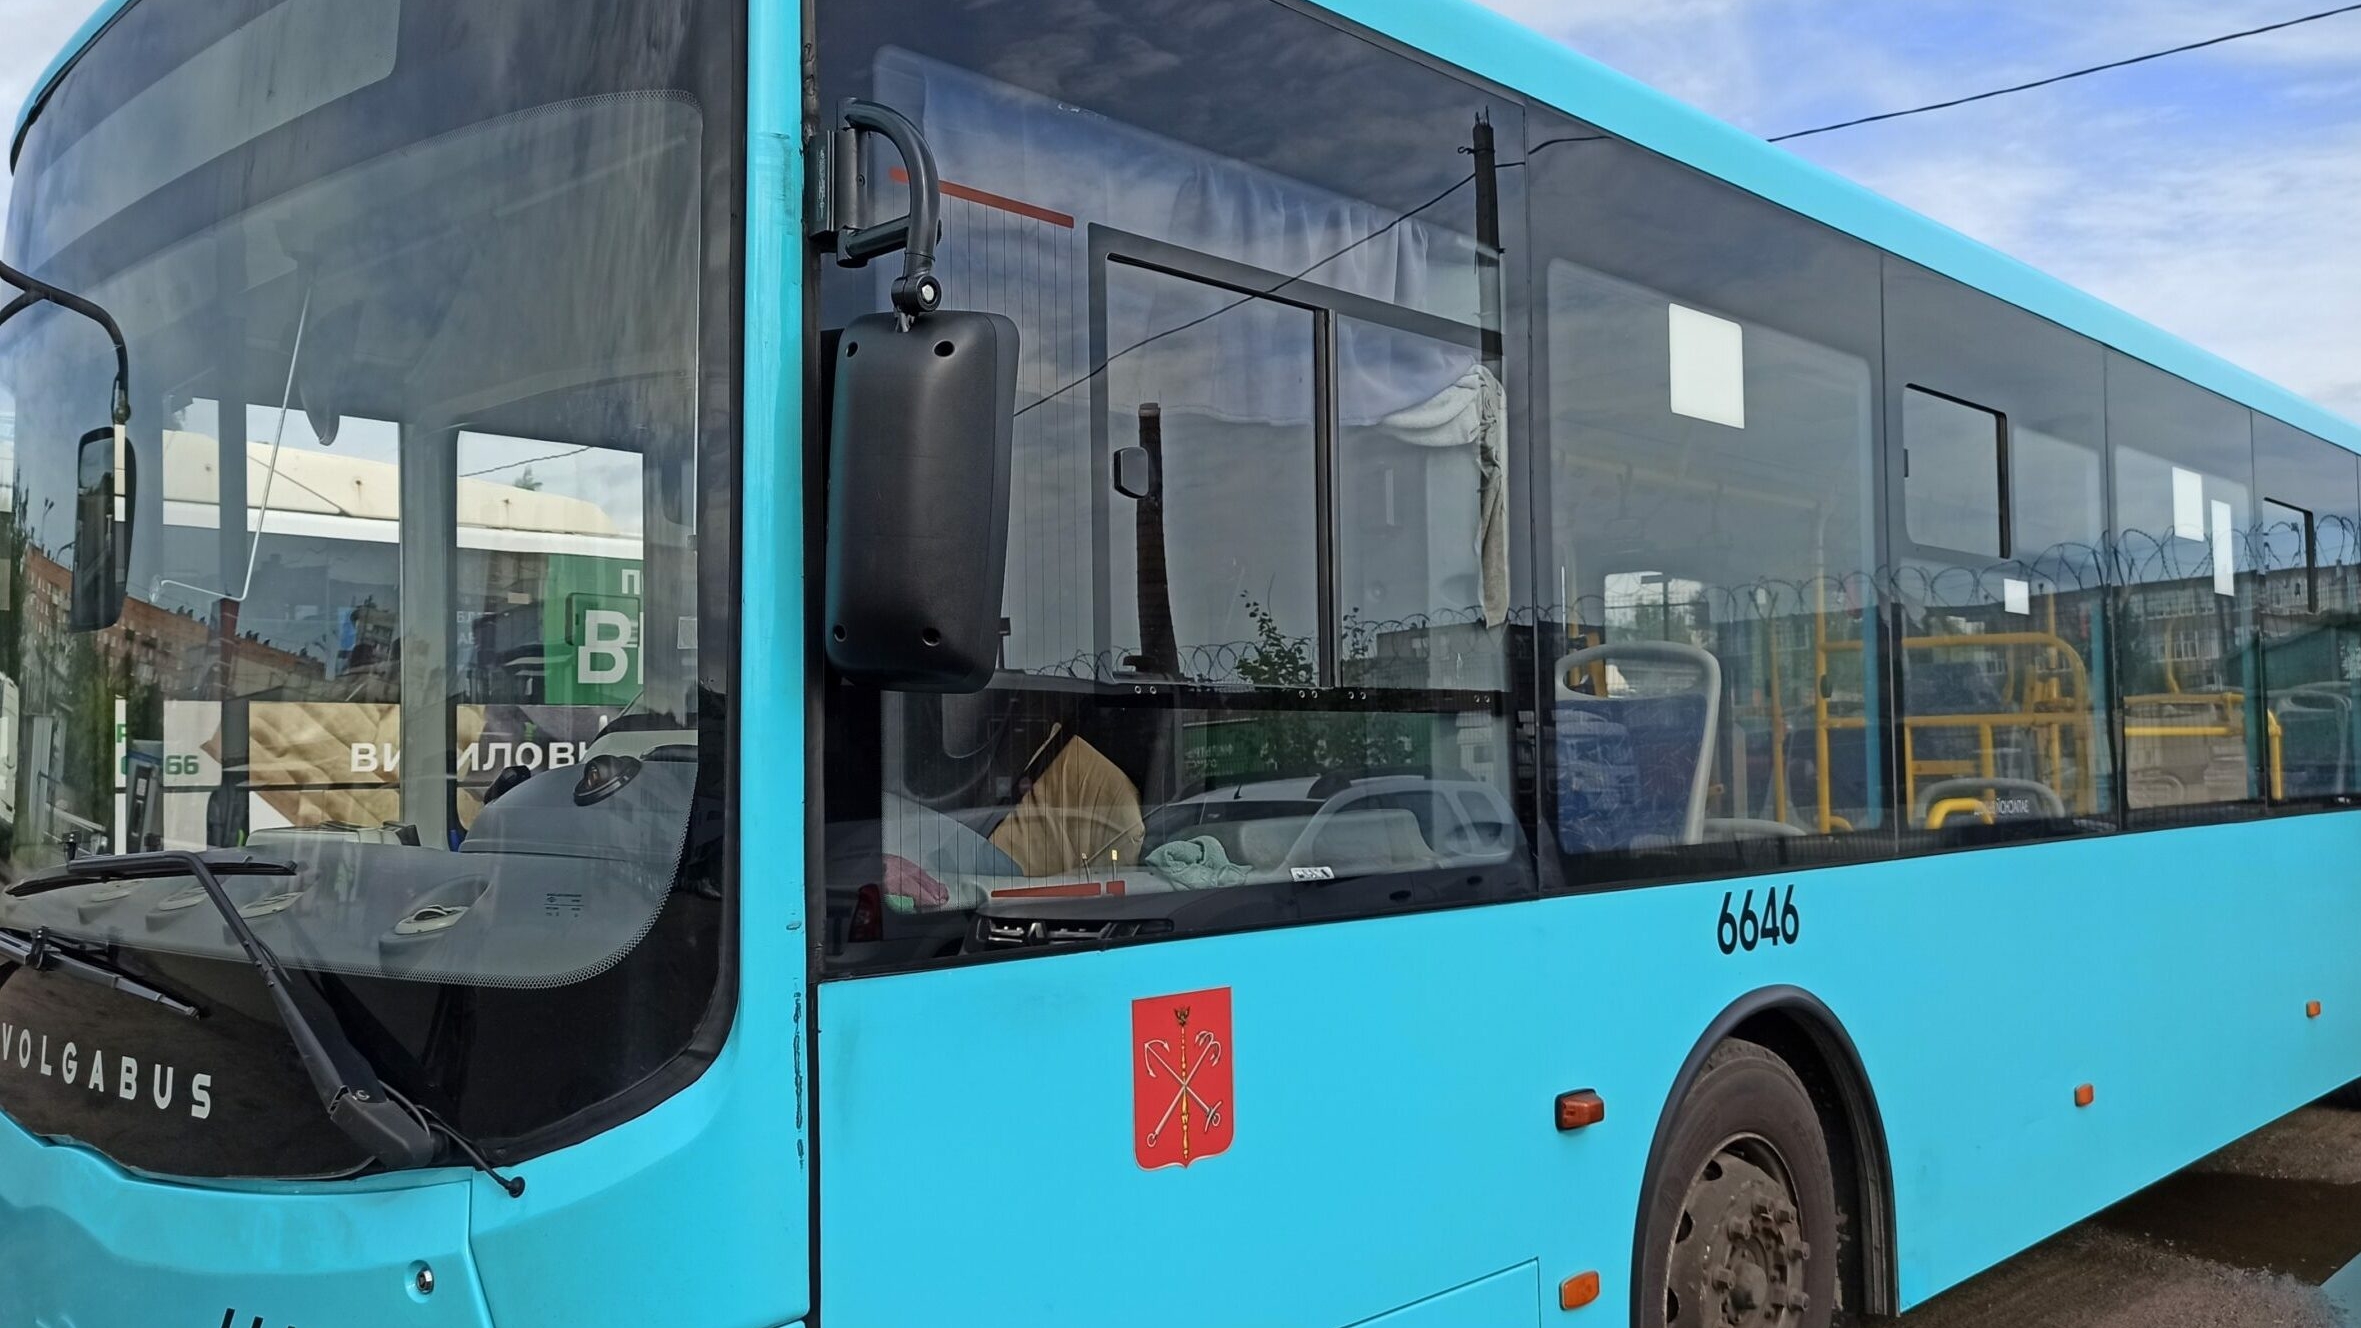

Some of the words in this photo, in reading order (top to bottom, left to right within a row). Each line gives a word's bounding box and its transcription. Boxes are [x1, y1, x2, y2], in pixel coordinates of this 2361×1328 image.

[578, 610, 643, 684] В
[1717, 884, 1799, 955] 6646
[3, 1022, 211, 1119] VOLGABUS
